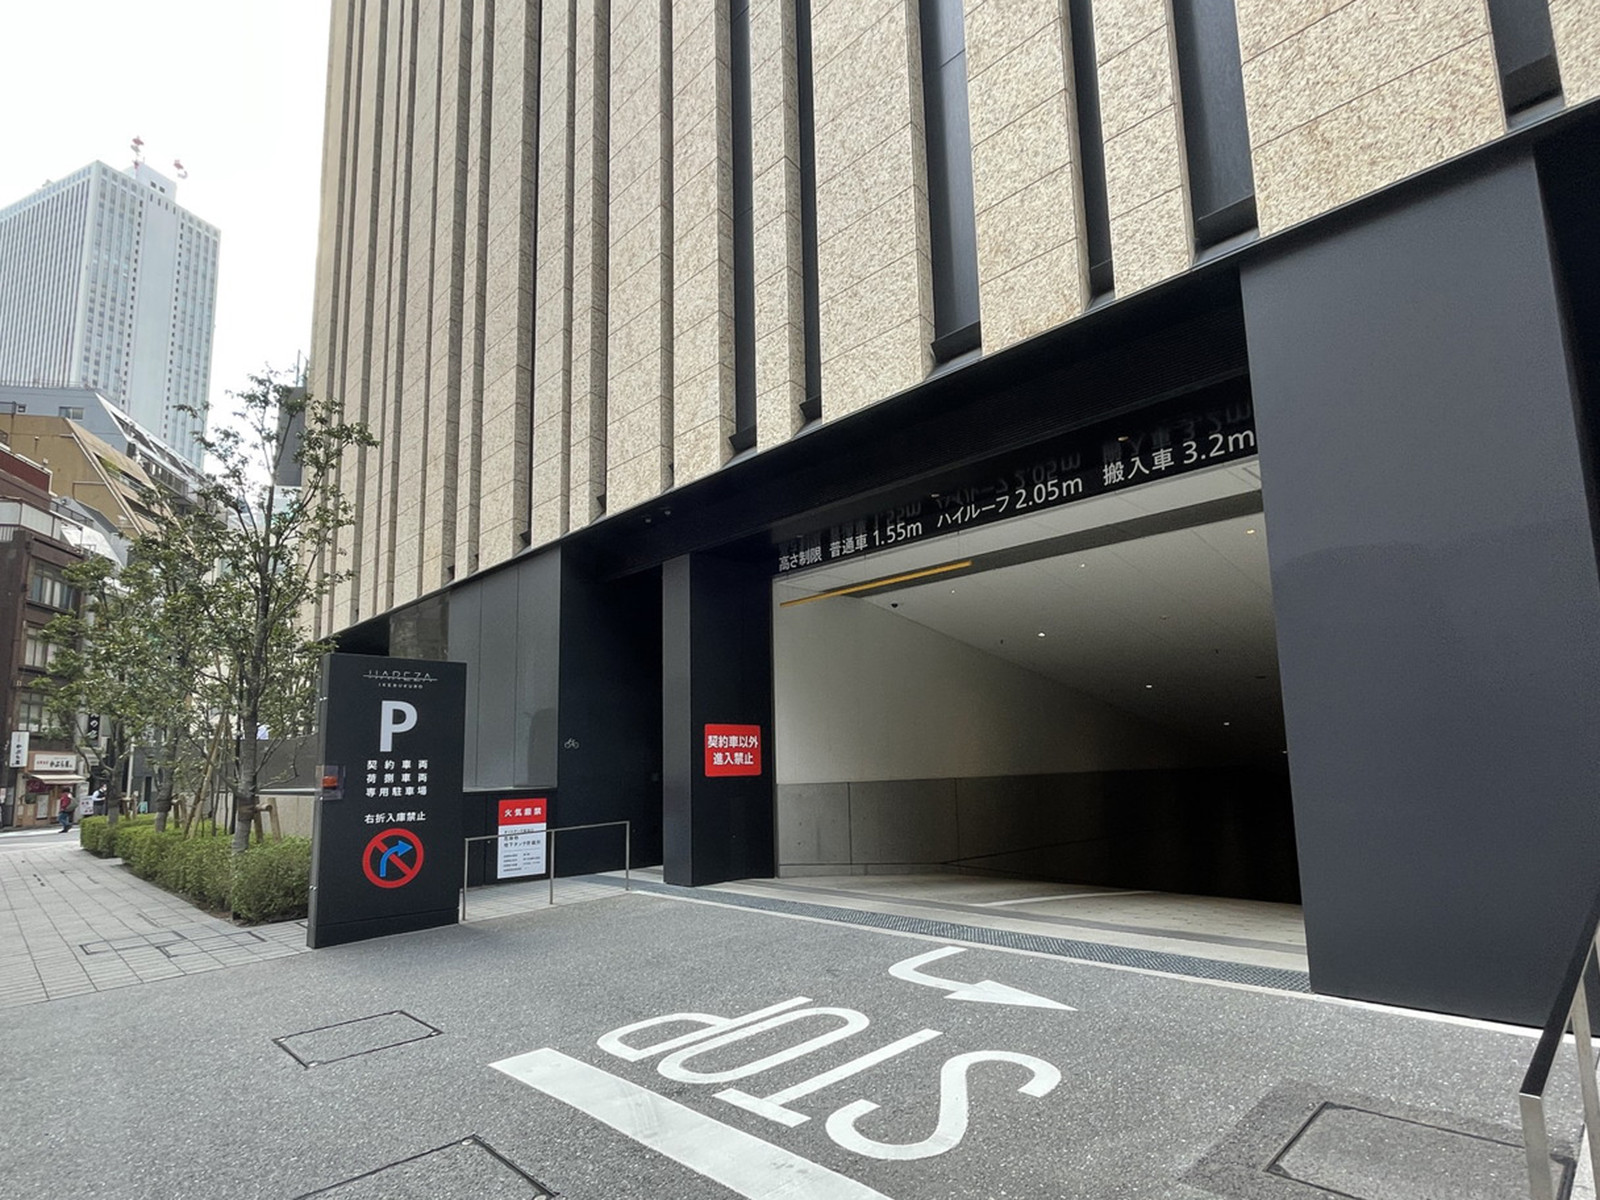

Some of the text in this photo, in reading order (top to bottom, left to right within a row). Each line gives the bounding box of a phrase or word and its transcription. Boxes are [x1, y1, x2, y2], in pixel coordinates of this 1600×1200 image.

[778, 429, 1255, 572] 高さ制限 普通車 1.55m ハイルーフ 2.05m 搬入車 3.2m
[379, 700, 418, 752] P
[707, 735, 759, 748] 契約車以外
[367, 760, 428, 770] 契約車両
[713, 752, 754, 765] 進入禁止
[365, 786, 428, 798] 専用駐車場
[364, 811, 427, 824] 右折入庫禁止
[504, 807, 542, 817] 火気厳禁
[596, 996, 1063, 1161] STOP
